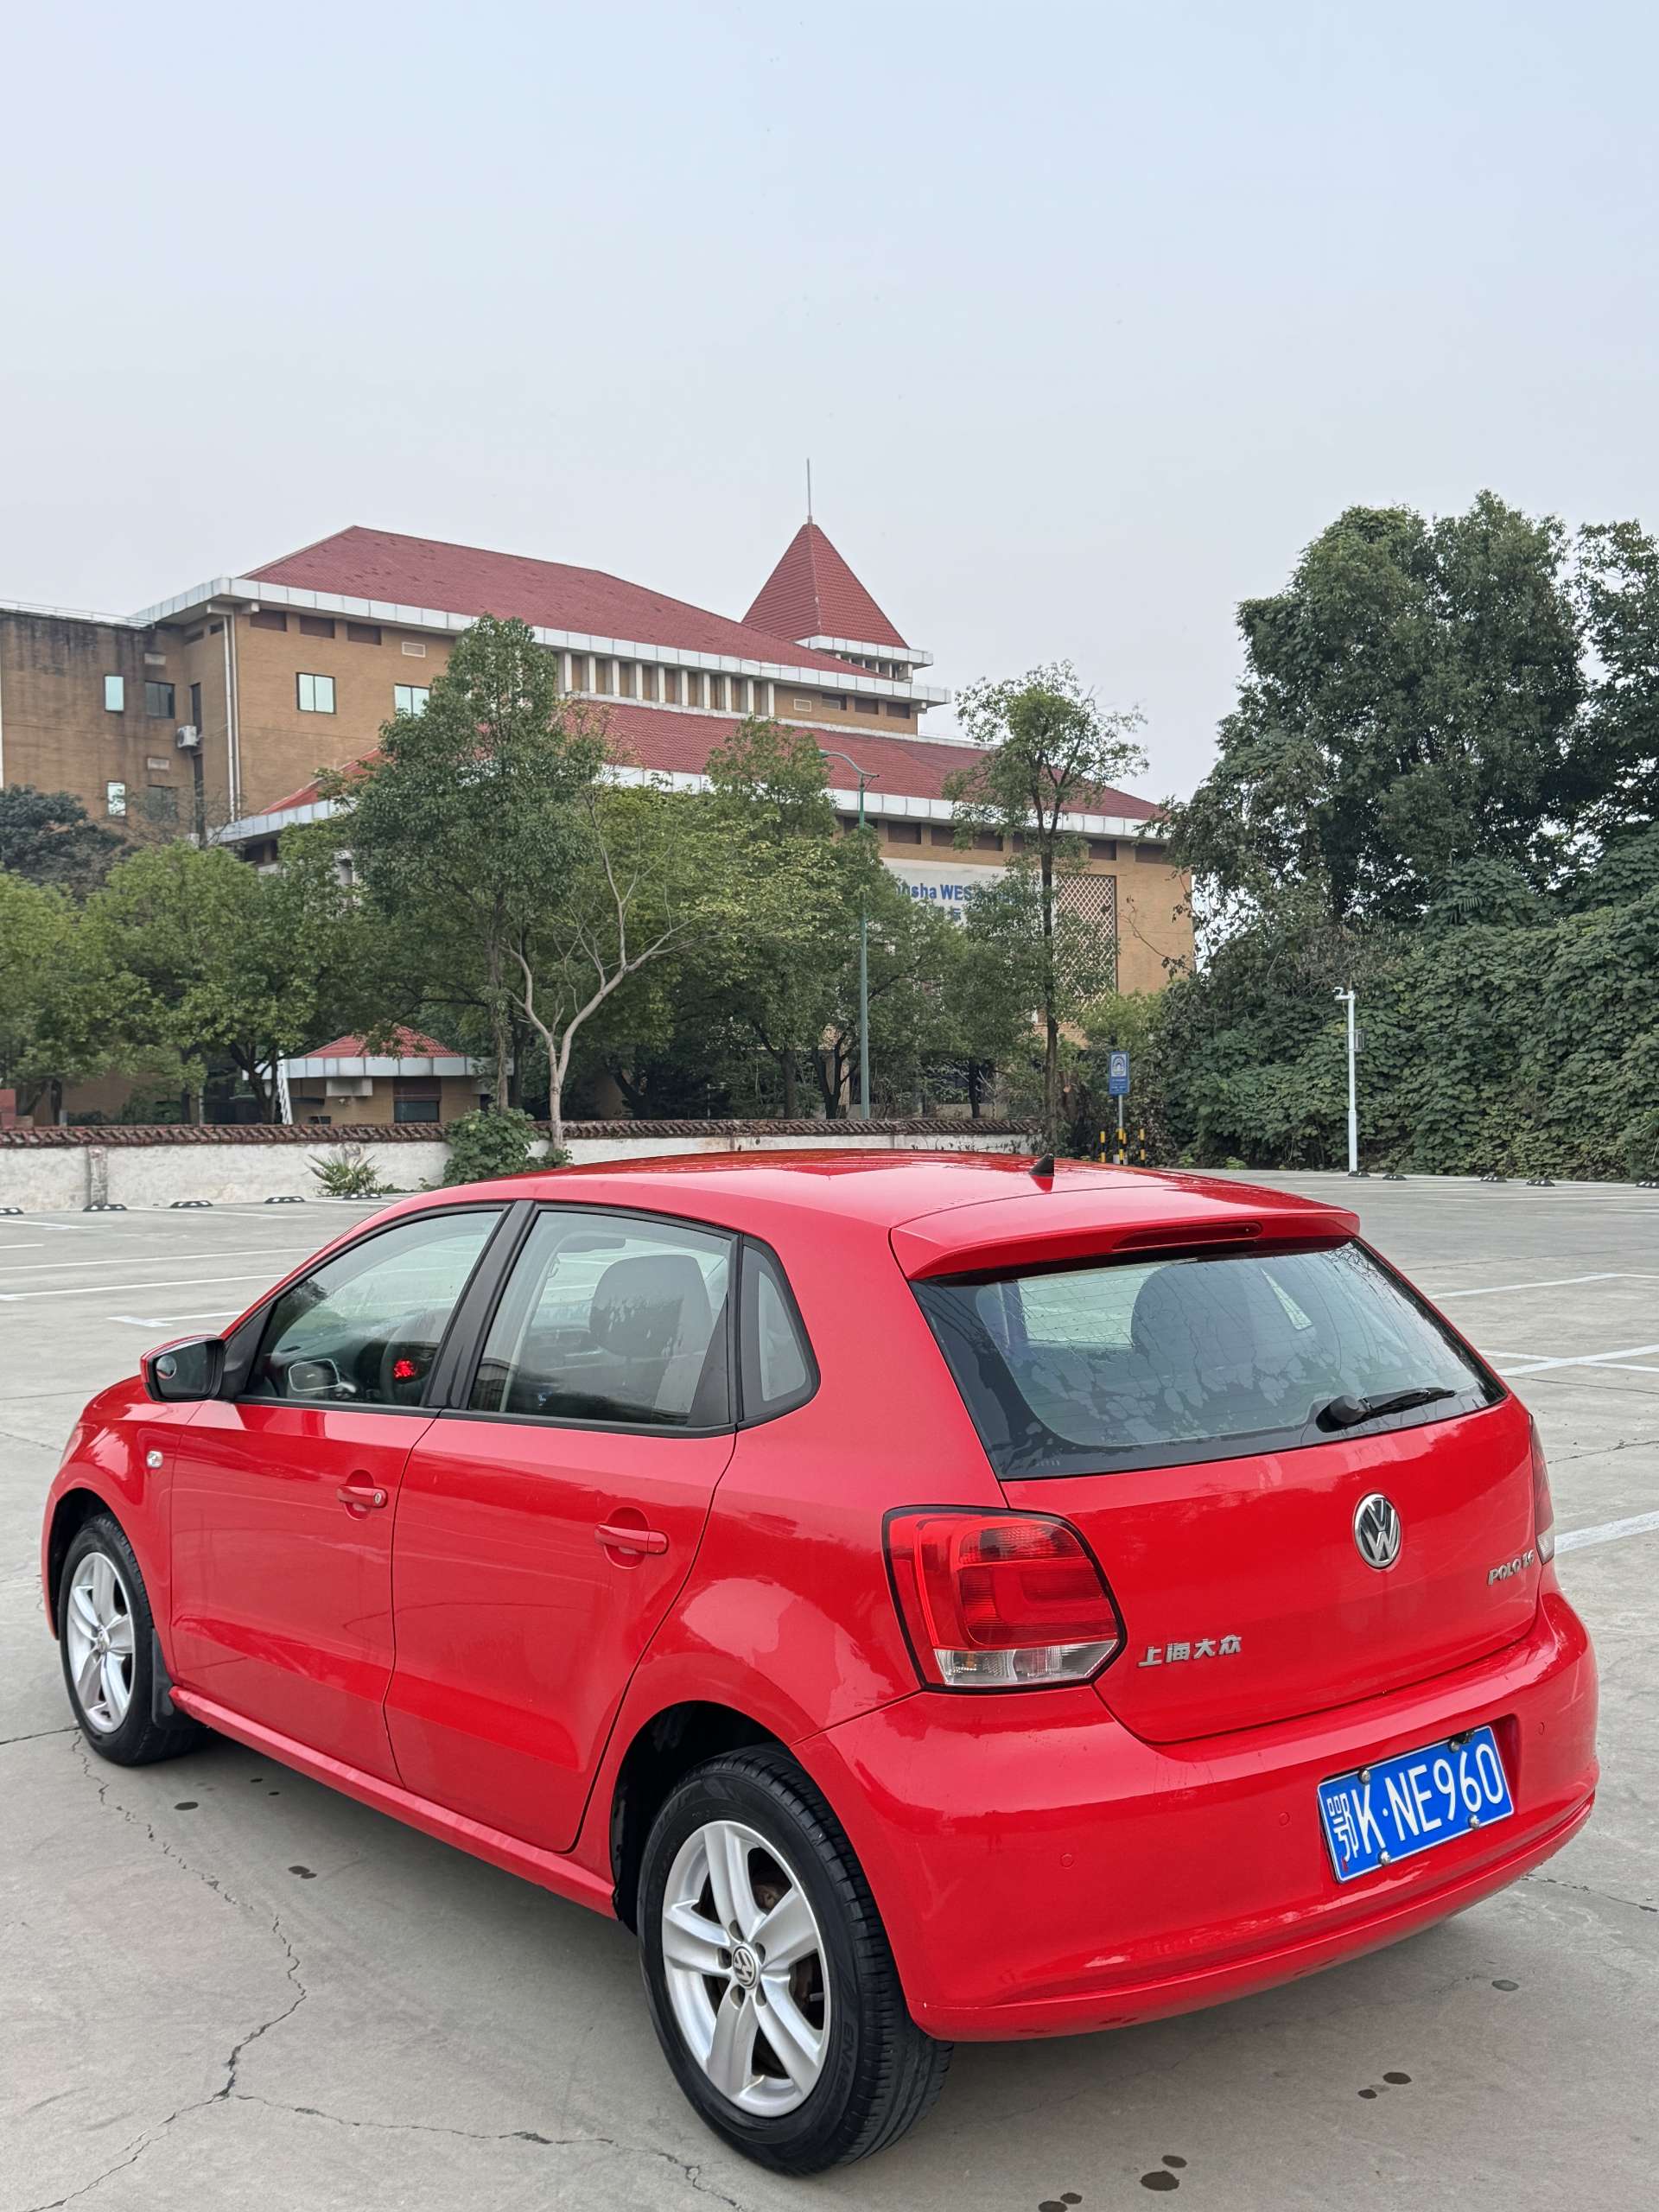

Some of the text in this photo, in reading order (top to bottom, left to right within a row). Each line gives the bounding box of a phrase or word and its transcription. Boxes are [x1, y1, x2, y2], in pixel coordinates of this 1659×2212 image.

[939, 884, 976, 902] WES
[1487, 1558, 1521, 1586] POLO
[1138, 1634, 1243, 1668] 上海大众
